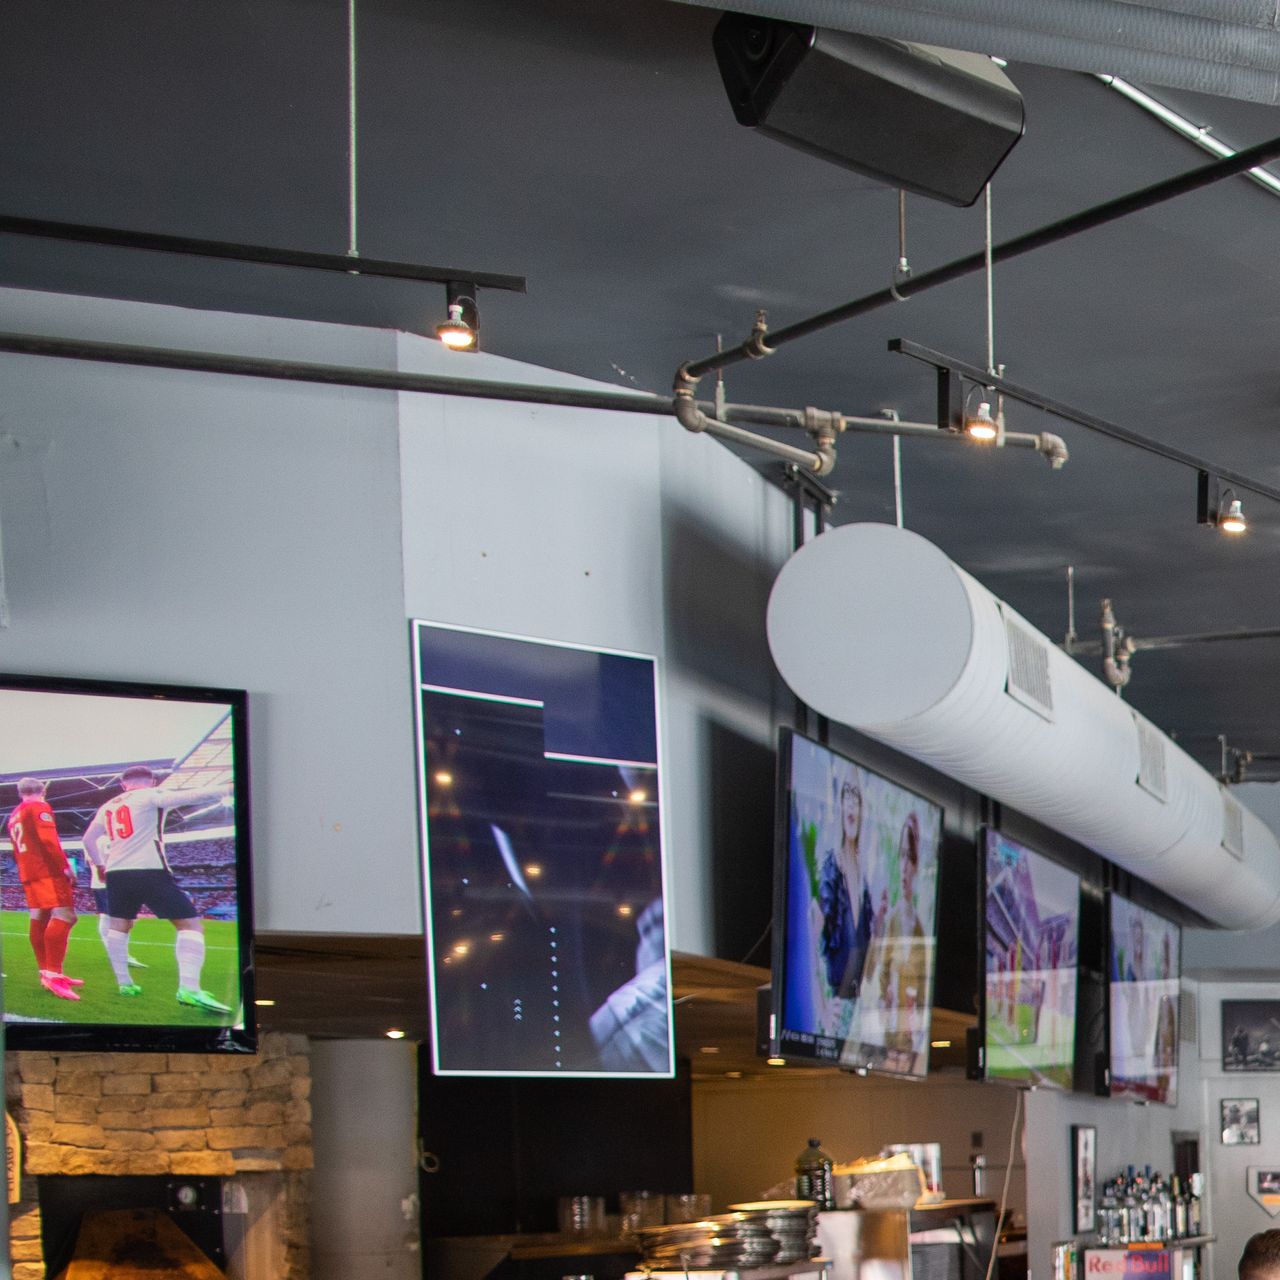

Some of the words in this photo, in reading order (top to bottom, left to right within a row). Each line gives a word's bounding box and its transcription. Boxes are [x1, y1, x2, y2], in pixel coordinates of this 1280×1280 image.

[105, 805, 134, 841] 19
[1088, 1252, 1128, 1273] Red
[1132, 1253, 1169, 1273] Bull
